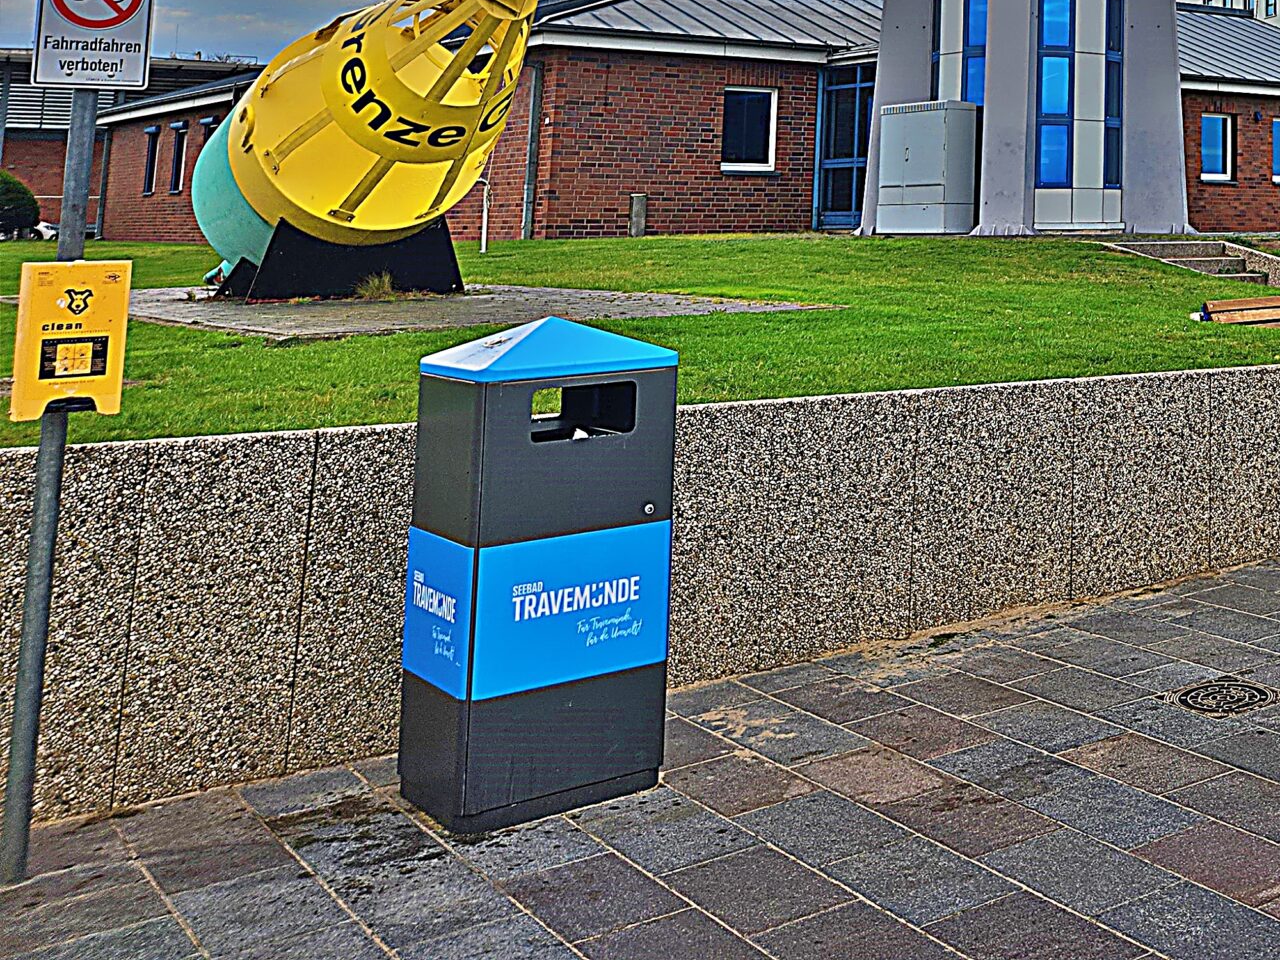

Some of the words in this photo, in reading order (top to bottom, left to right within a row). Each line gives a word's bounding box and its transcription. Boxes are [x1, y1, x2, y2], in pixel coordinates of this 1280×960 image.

[44, 35, 141, 53] Fahrradfahren
[59, 57, 124, 73] verboten!
[41, 322, 83, 332] clean
[512, 581, 543, 596] SEEBAD
[413, 581, 456, 624] TRAVEMÜNDE
[512, 575, 640, 622] TRAVEMÜNDE
